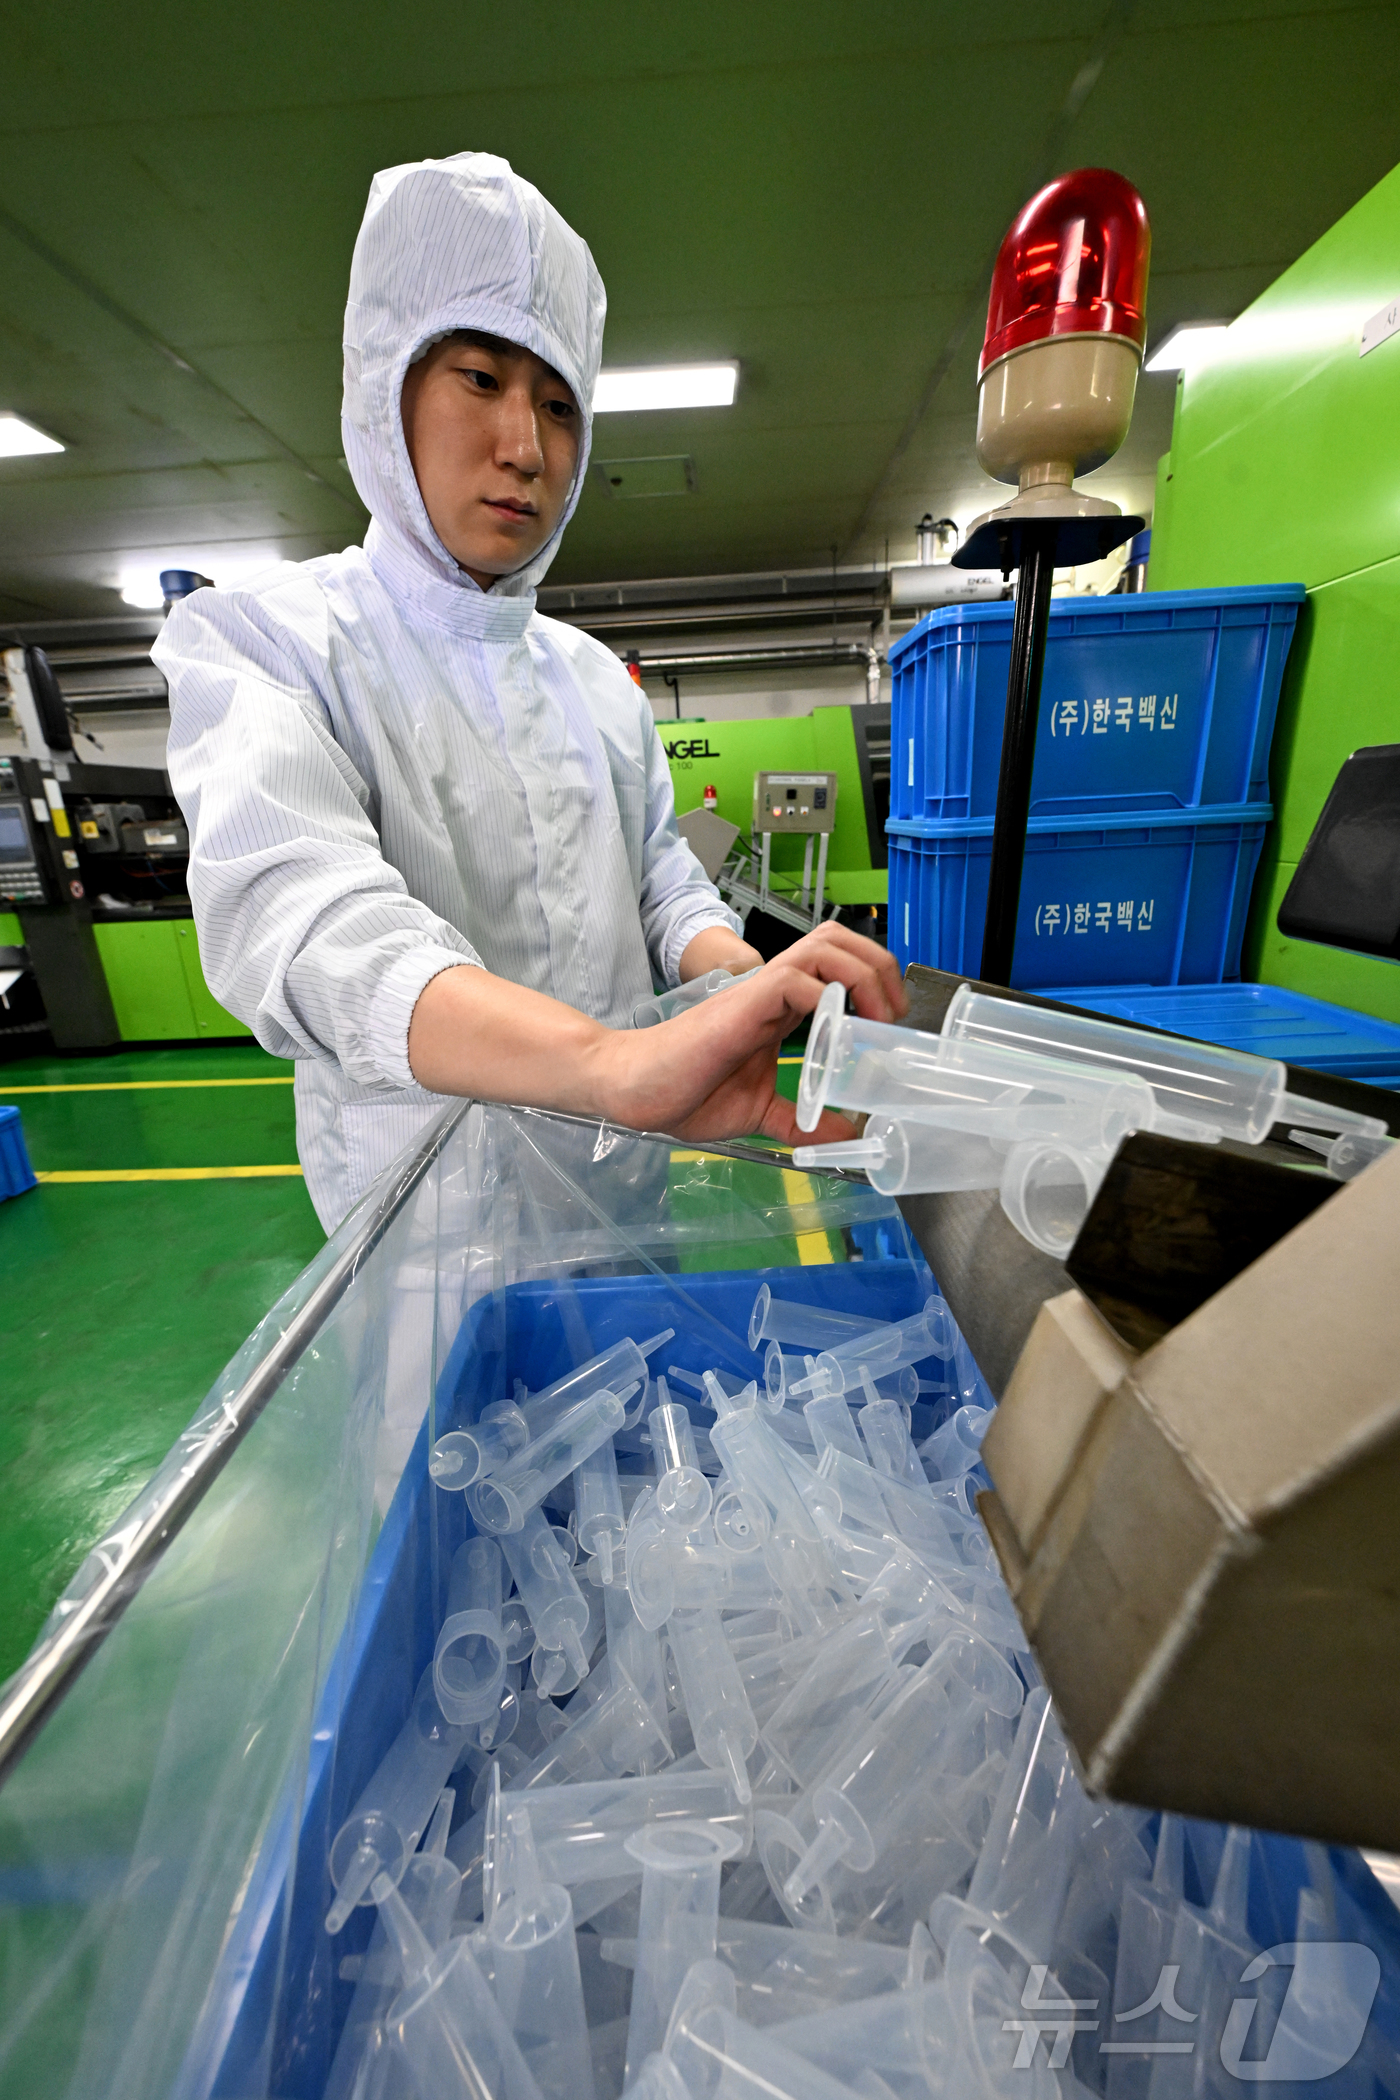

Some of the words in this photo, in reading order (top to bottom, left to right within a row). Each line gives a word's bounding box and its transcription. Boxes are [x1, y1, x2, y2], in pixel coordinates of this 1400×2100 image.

[1050, 693, 1178, 737] (주)한국백신
[663, 738, 720, 760] NGEL
[1035, 899, 1154, 936] (주)한국백신
